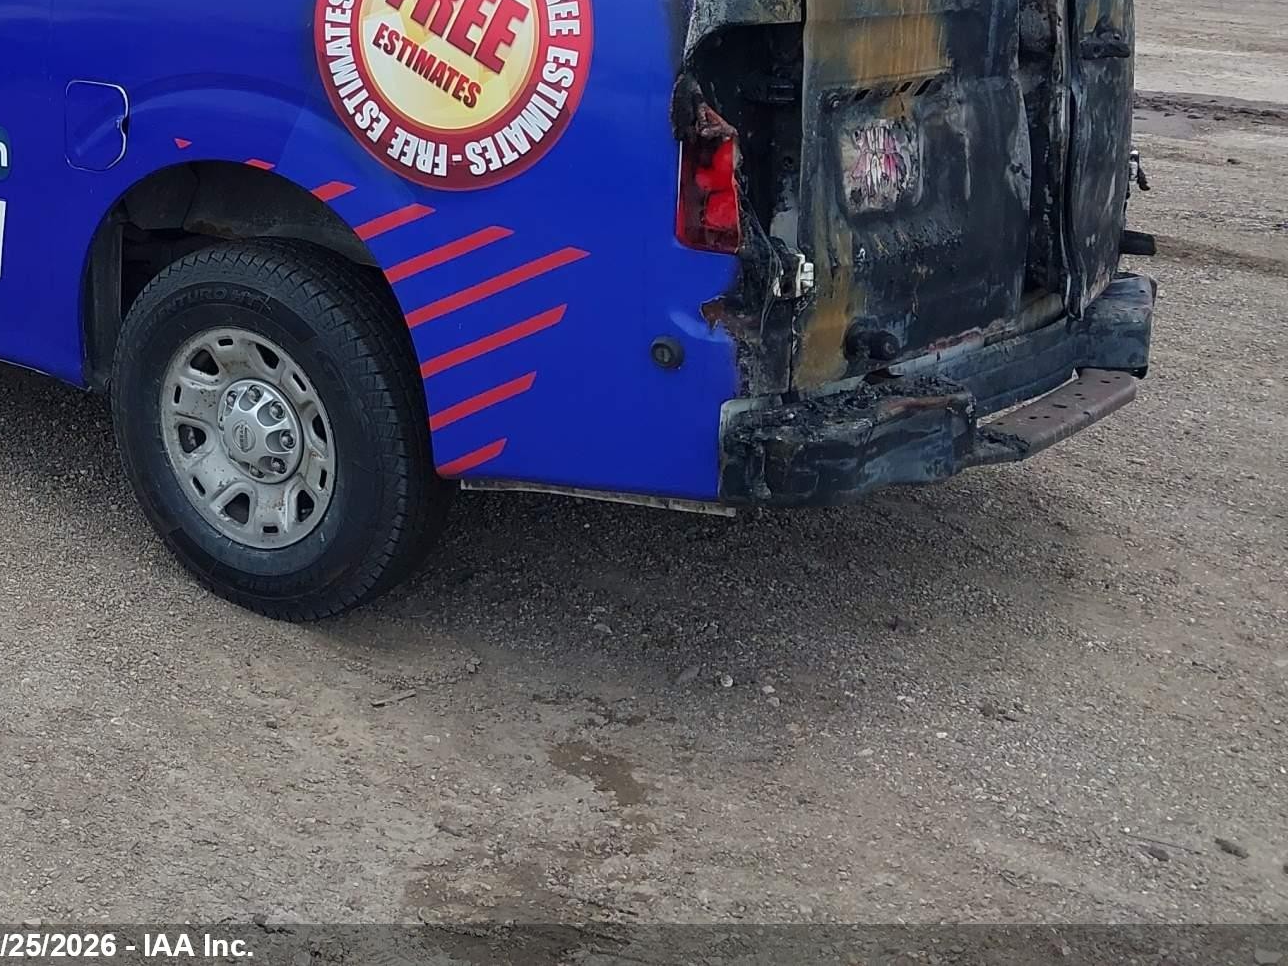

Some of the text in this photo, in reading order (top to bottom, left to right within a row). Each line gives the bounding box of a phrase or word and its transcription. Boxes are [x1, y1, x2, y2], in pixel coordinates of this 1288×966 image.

[372, 22, 482, 109] ESTIMATES
[464, 46, 580, 178] ESTIMATES
[385, 134, 449, 178] FREE
